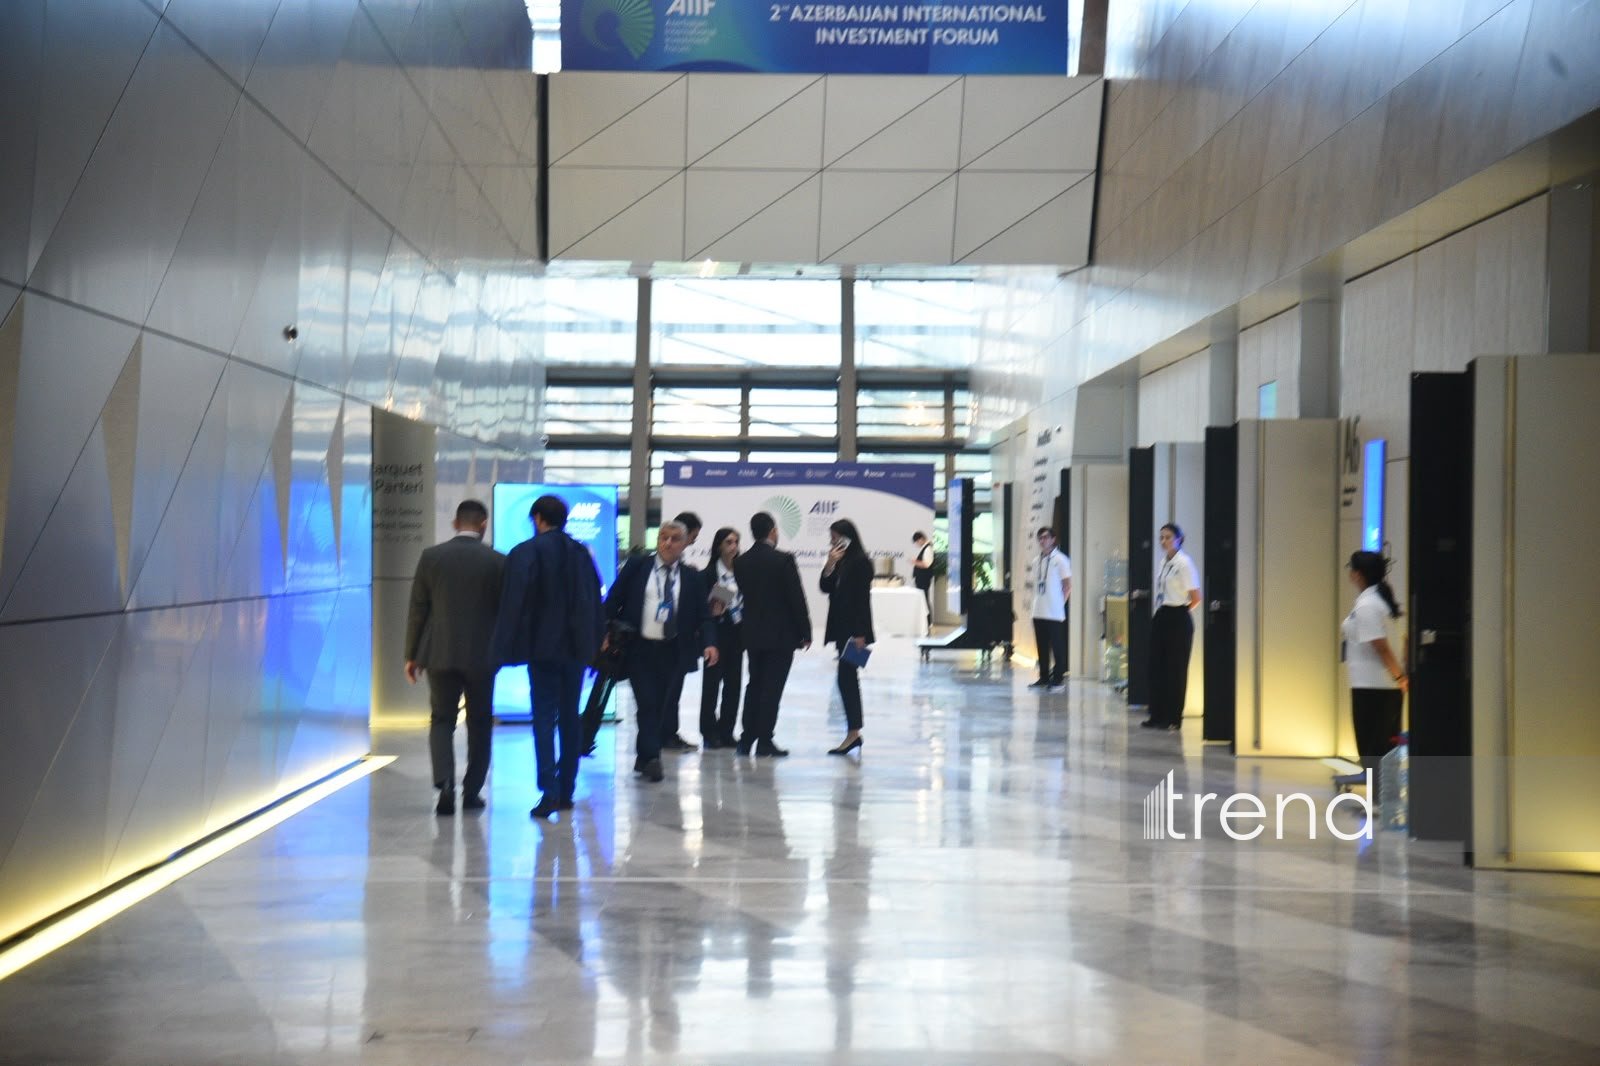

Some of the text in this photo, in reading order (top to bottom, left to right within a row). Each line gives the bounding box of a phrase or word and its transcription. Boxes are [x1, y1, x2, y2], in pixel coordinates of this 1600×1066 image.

[665, 0, 716, 16] AIIF
[789, 5, 898, 23] AZERBAIJAN
[902, 5, 1047, 23] INTERNATIONAL
[815, 27, 999, 45] INVESTMENT FORUM
[372, 463, 423, 480] arquet
[808, 500, 841, 515] AIIF
